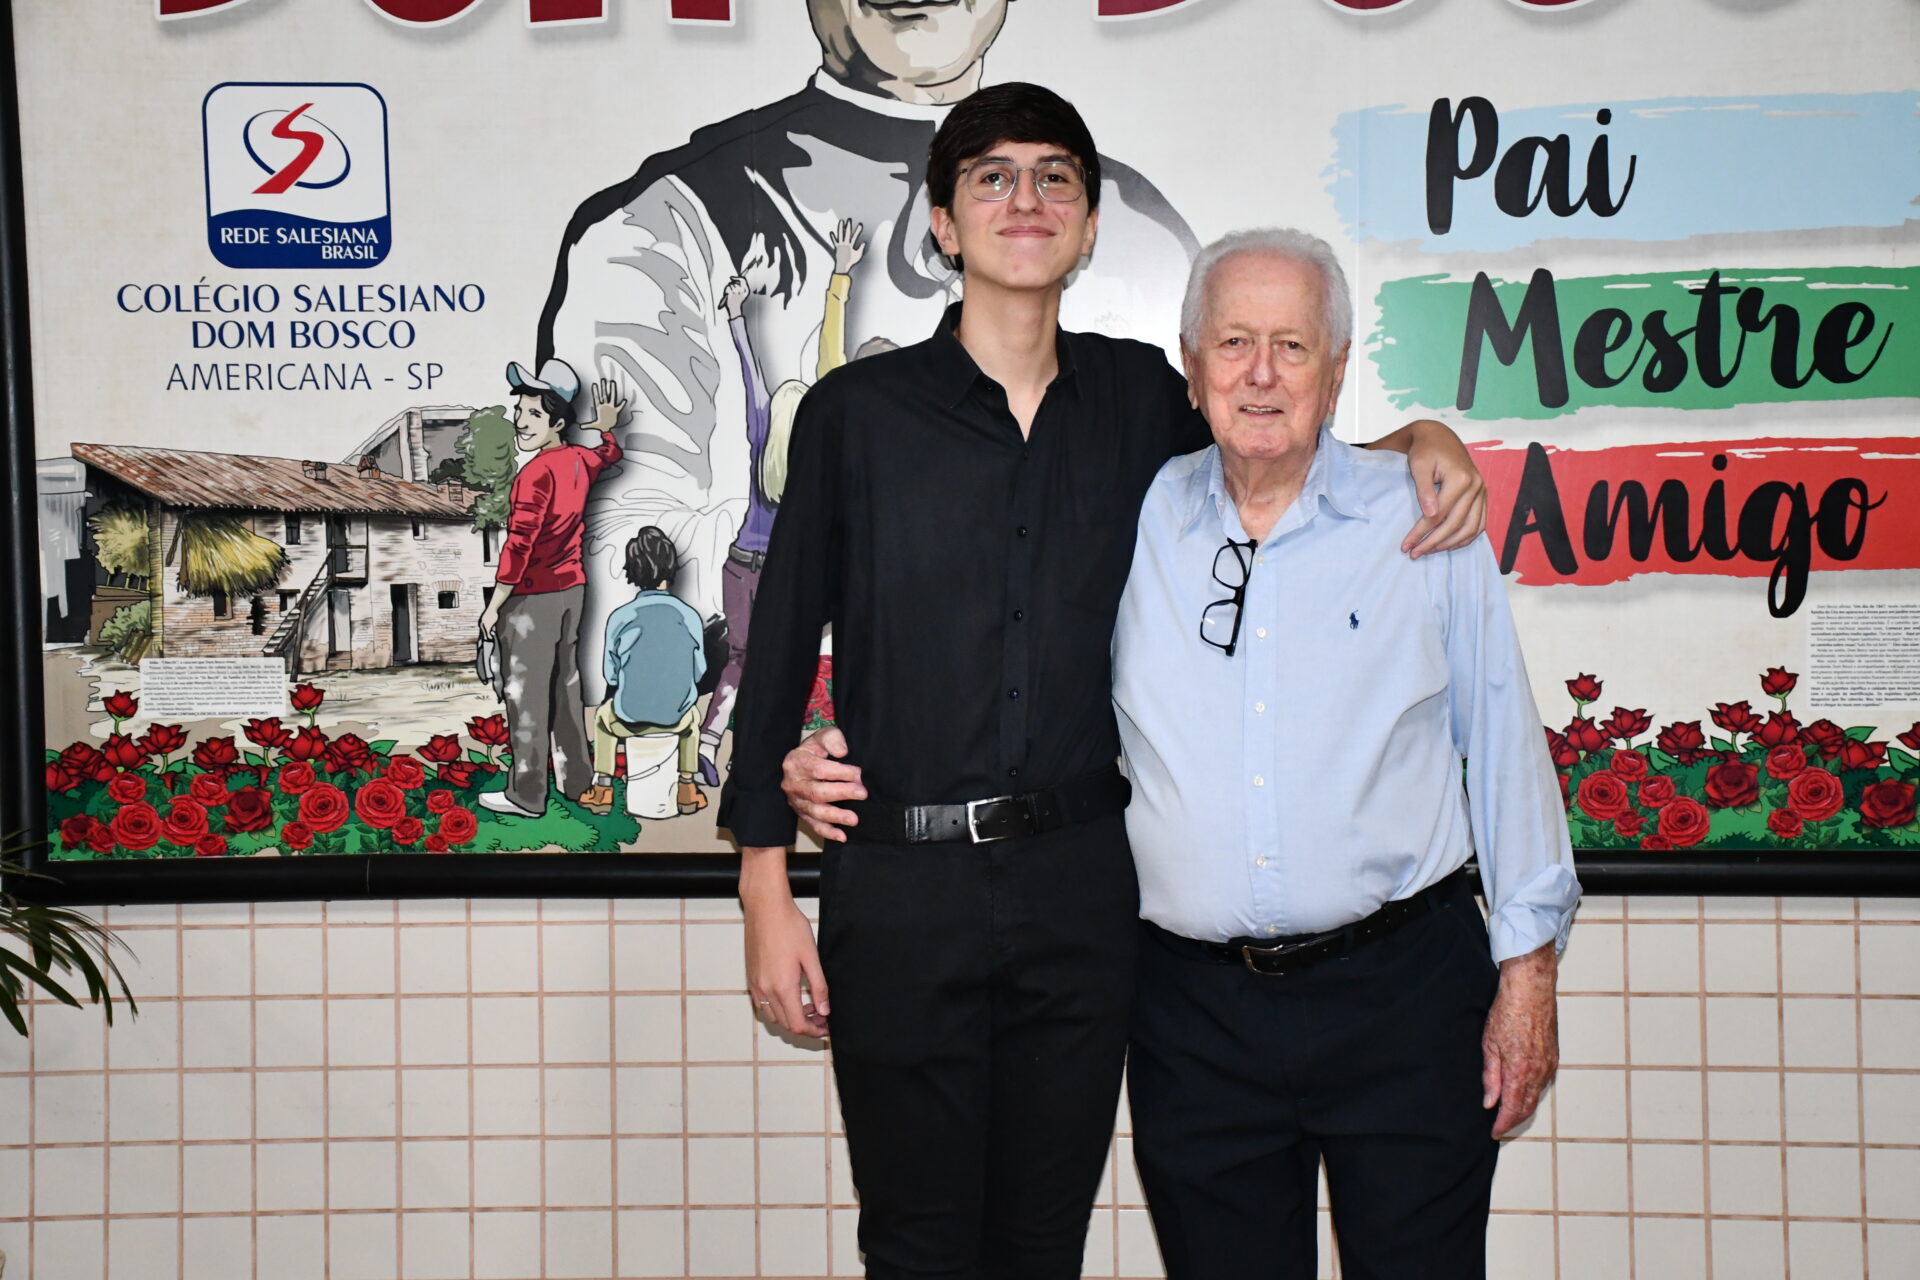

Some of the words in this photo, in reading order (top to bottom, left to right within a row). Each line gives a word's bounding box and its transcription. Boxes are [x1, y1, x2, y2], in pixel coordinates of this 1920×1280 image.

[1426, 96, 1637, 235] Pai
[221, 227, 270, 244] REDE
[276, 227, 379, 244] SALESIANA
[321, 245, 378, 260] BRASIL
[116, 276, 280, 313] COLÉGIO
[293, 283, 485, 313] SALESIANO
[192, 320, 275, 349] DOM
[290, 320, 416, 349] BOSCO
[1456, 267, 1894, 411] Mestre
[166, 362, 372, 391] AMERICANA
[407, 362, 443, 390] SP
[1500, 442, 1888, 619] Amigo
